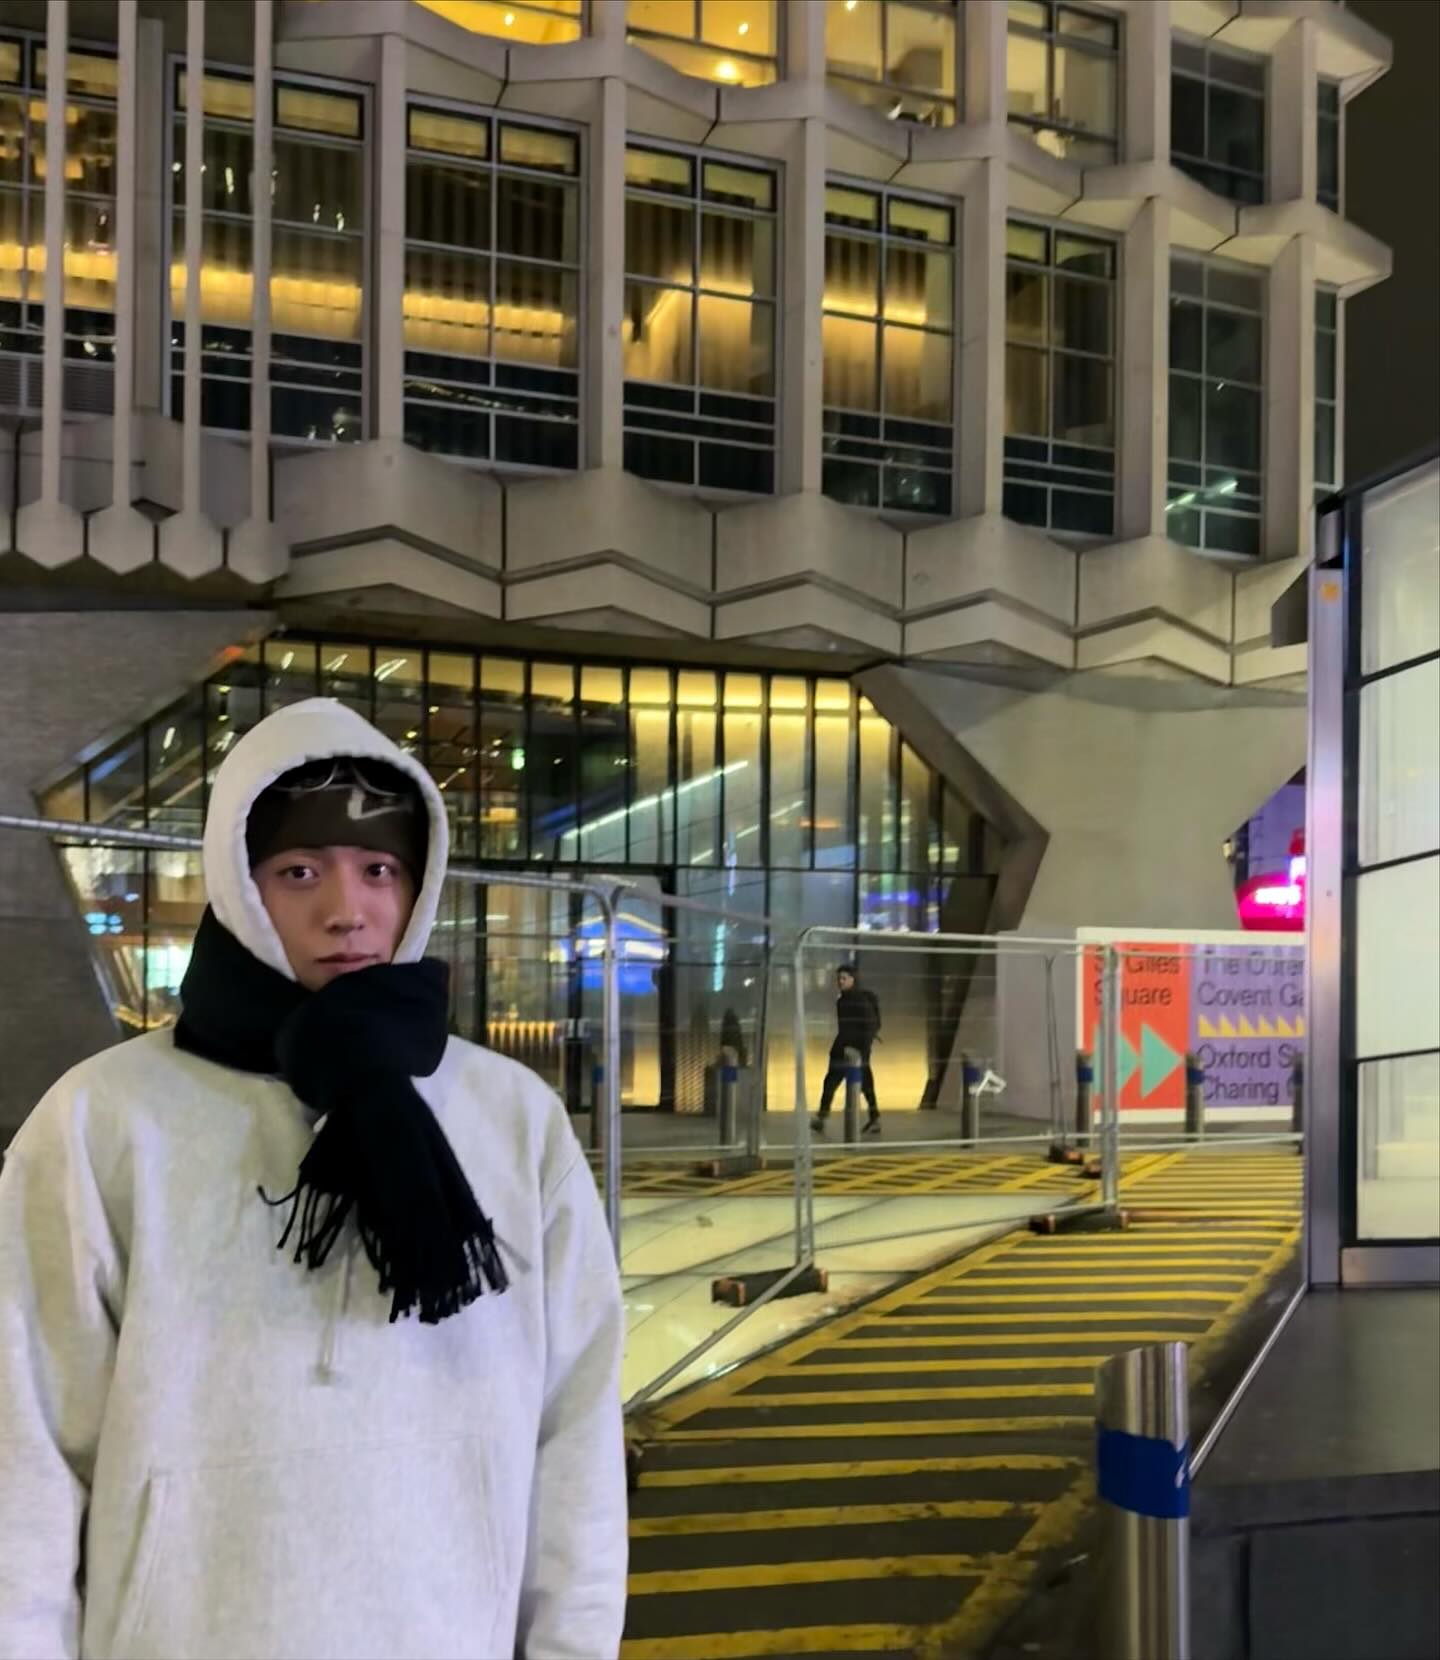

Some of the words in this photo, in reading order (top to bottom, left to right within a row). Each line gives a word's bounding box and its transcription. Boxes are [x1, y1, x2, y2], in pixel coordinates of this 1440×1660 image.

[1125, 948, 1179, 974] Giles
[1203, 950, 1240, 976] The
[1198, 981, 1273, 1007] Covent
[1197, 1043, 1270, 1069] Oxford
